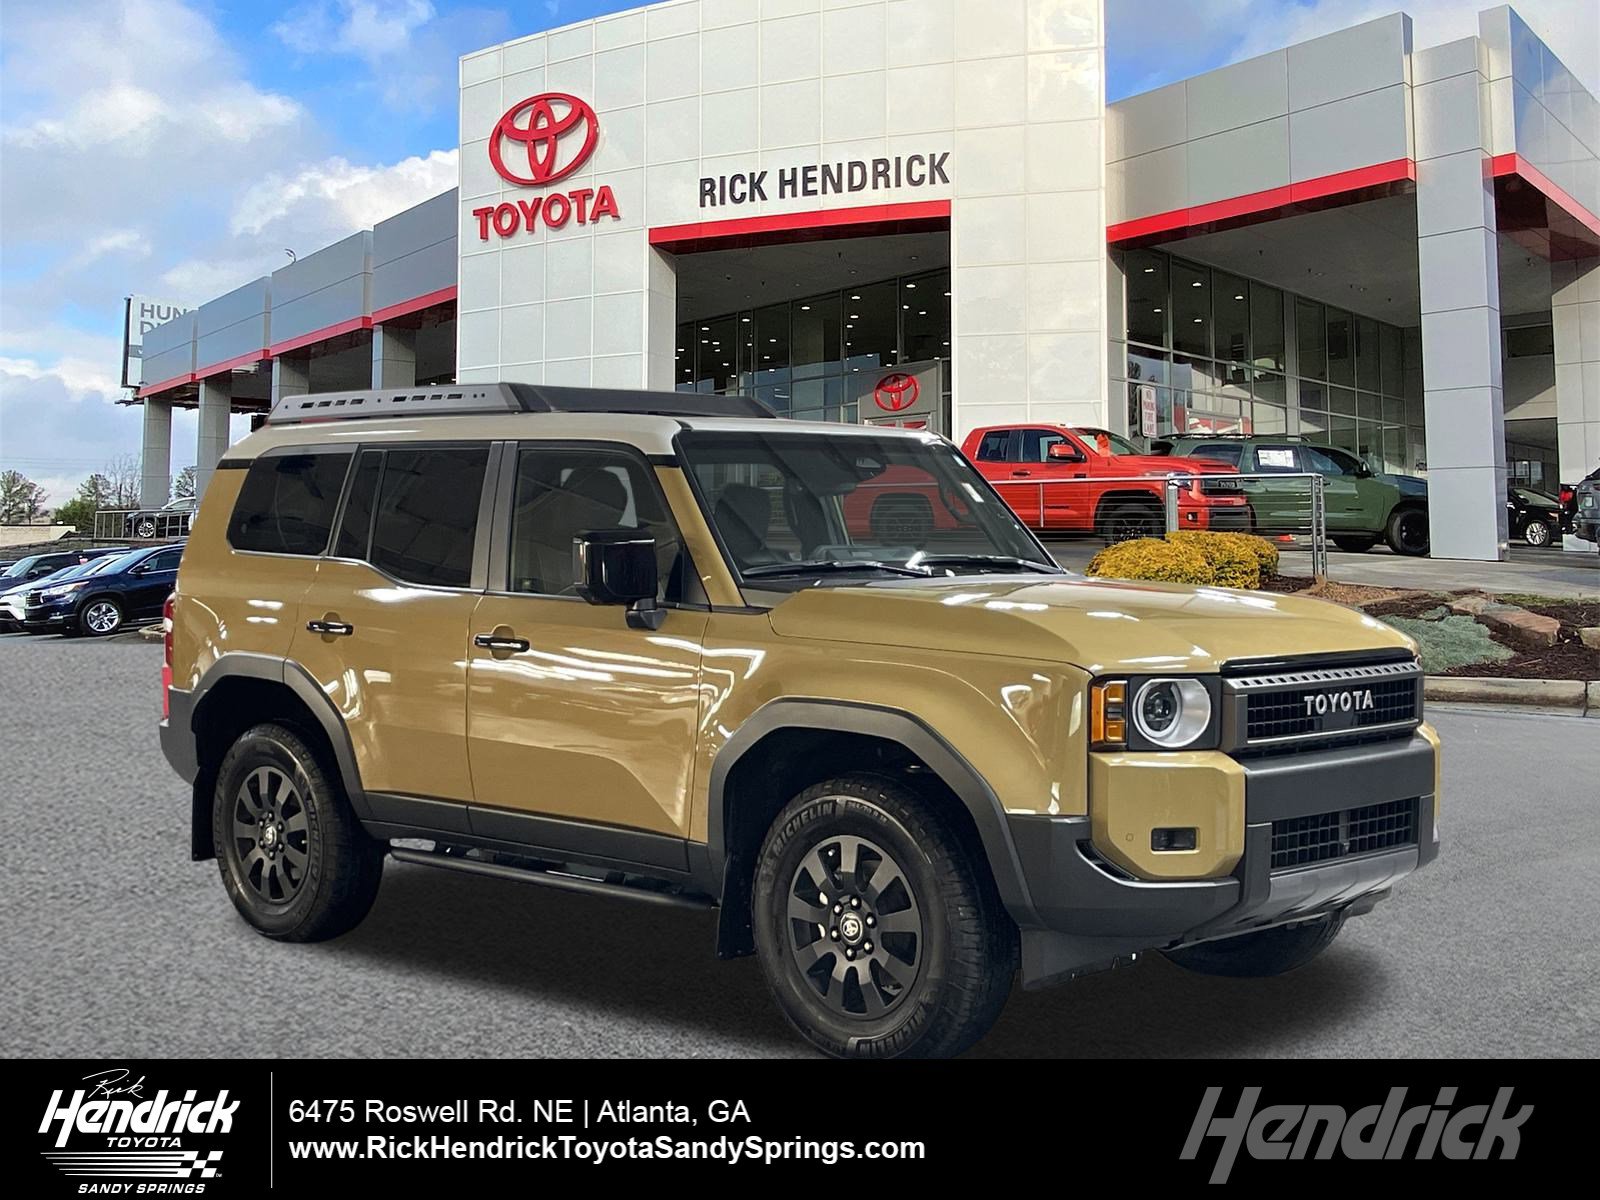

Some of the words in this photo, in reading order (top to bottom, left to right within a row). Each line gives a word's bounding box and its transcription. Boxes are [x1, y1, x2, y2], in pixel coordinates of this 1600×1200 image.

[699, 171, 768, 208] RICK
[779, 152, 951, 200] HENDRICK
[473, 185, 620, 241] TOYOTA
[1304, 690, 1374, 716] TOYOTA
[772, 801, 833, 856] MICHELIN
